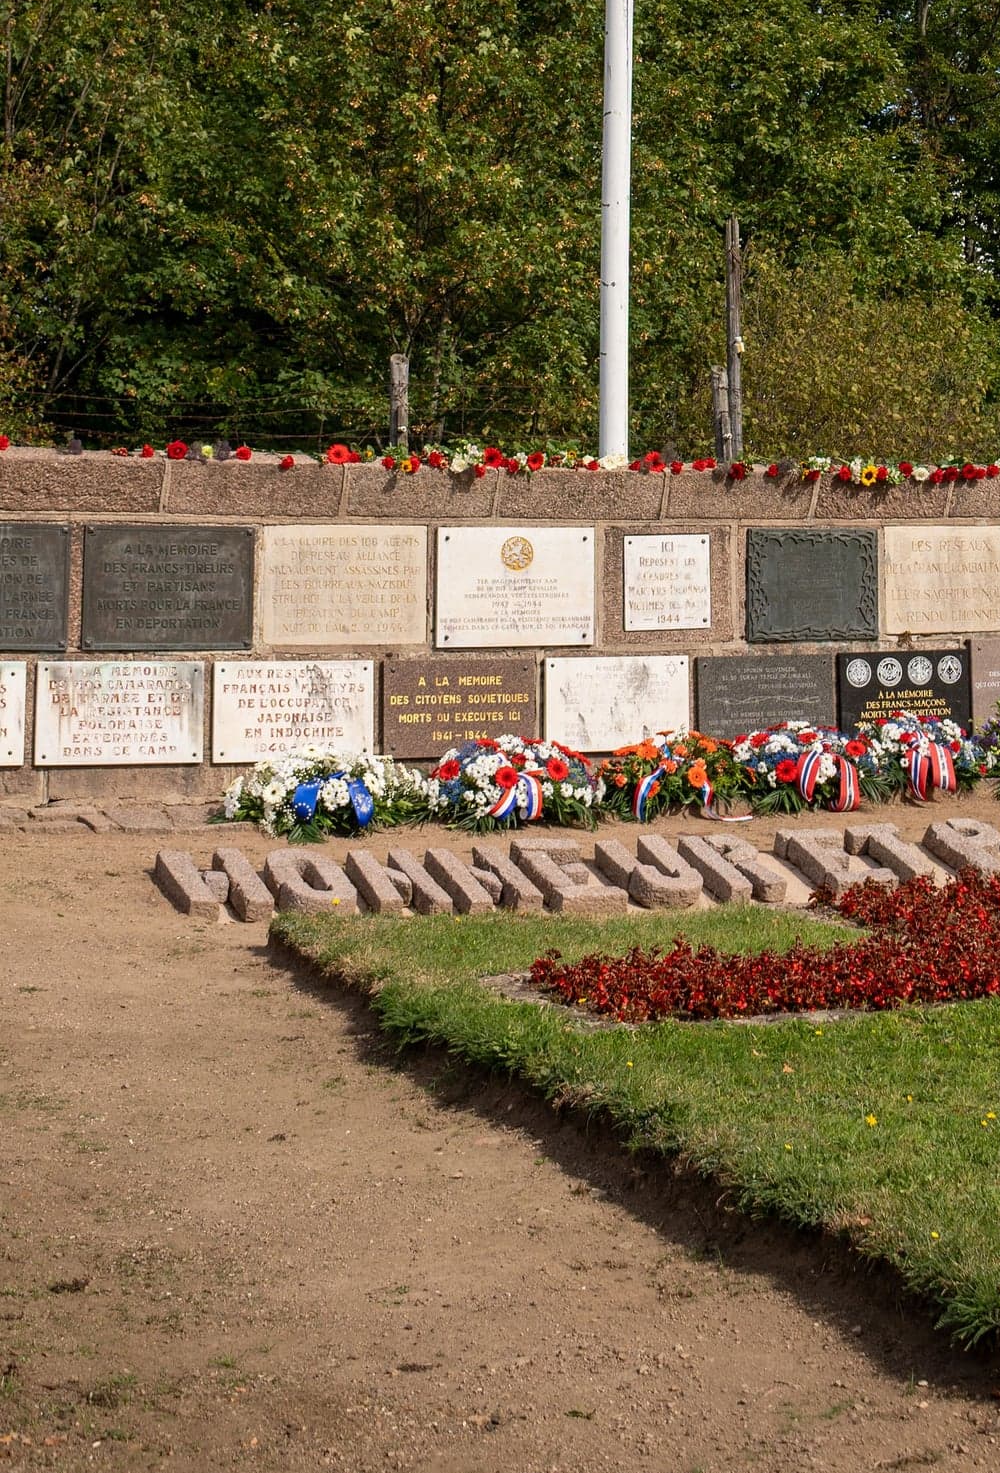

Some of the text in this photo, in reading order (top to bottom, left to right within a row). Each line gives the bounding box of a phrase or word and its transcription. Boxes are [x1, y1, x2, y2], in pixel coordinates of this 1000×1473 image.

[138, 544, 153, 556] LA
[661, 541, 674, 553] ICI
[911, 540, 933, 553] LES
[104, 561, 235, 574] DES FRANCS-TIREURS
[122, 580, 217, 593] ET PARTISANS
[97, 599, 241, 611] MORTS POUR LA FRANCE
[6, 609, 56, 620] FRANCE
[657, 613, 680, 625] 1944
[116, 618, 133, 629] EN
[237, 669, 263, 679] AUX
[108, 679, 192, 690] CAMARADES
[418, 676, 503, 687] A LA MEMOIRE
[223, 682, 366, 695] FRANÇAIS MARTYRS
[886, 691, 895, 699] LA
[897, 689, 934, 699] MÉMOIRE
[52, 694, 70, 704] DE
[148, 693, 166, 703] ET
[239, 697, 351, 709] DE L'OCCUPATION
[390, 693, 529, 705] DES CITOYENS SOVIETIQUES
[866, 698, 947, 709] DES FRANCS-MAÇONS
[60, 707, 79, 717] LA
[257, 712, 333, 724] JAPONAISE
[399, 711, 521, 723] MORTS OU EXECUTES ICI
[861, 710, 887, 719] MORTS
[78, 720, 163, 730] POLONAISE
[245, 726, 345, 739] EN INDOCHINE
[63, 746, 103, 757] DANS
[139, 745, 177, 756] CAMP
[154, 834, 788, 923] HONNEUR
[772, 823, 902, 899] ET
